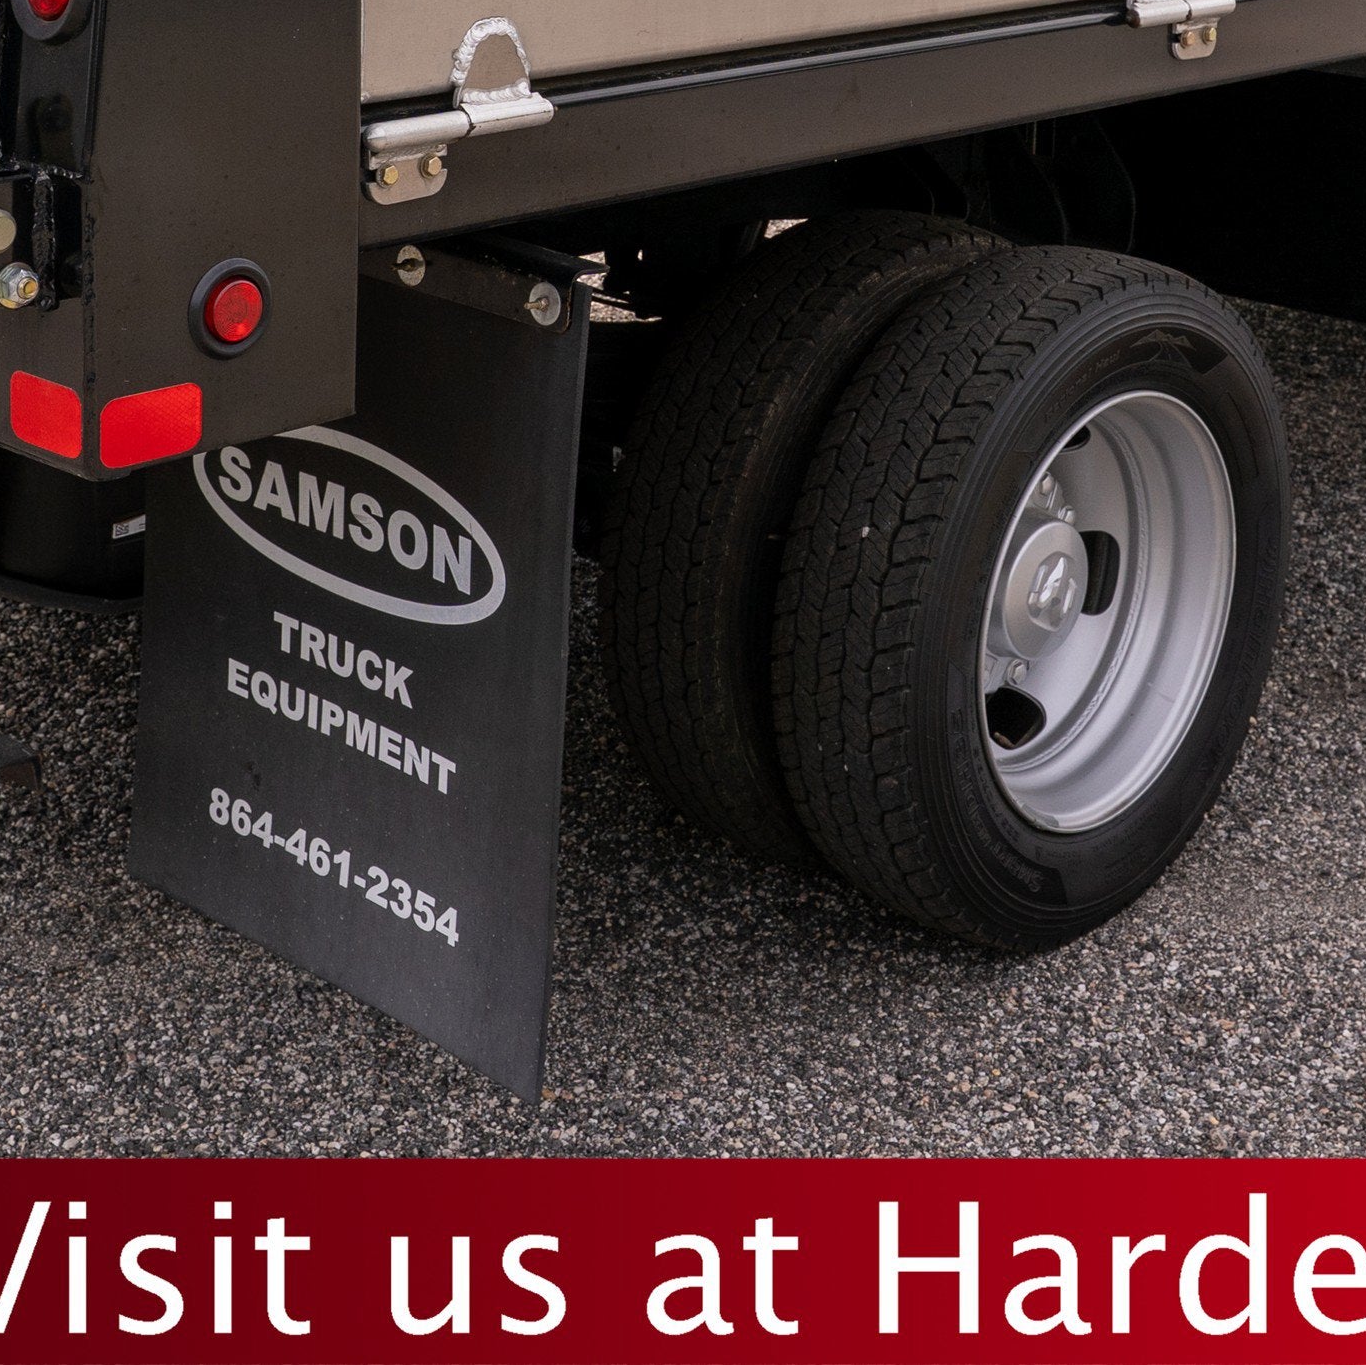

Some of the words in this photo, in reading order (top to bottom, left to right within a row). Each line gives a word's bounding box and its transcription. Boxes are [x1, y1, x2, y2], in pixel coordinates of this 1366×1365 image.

[218, 445, 472, 596] SAMSON
[227, 657, 457, 795] EQUIPMENT
[273, 610, 414, 710] TRUCK
[208, 787, 460, 948] 864-461-2354
